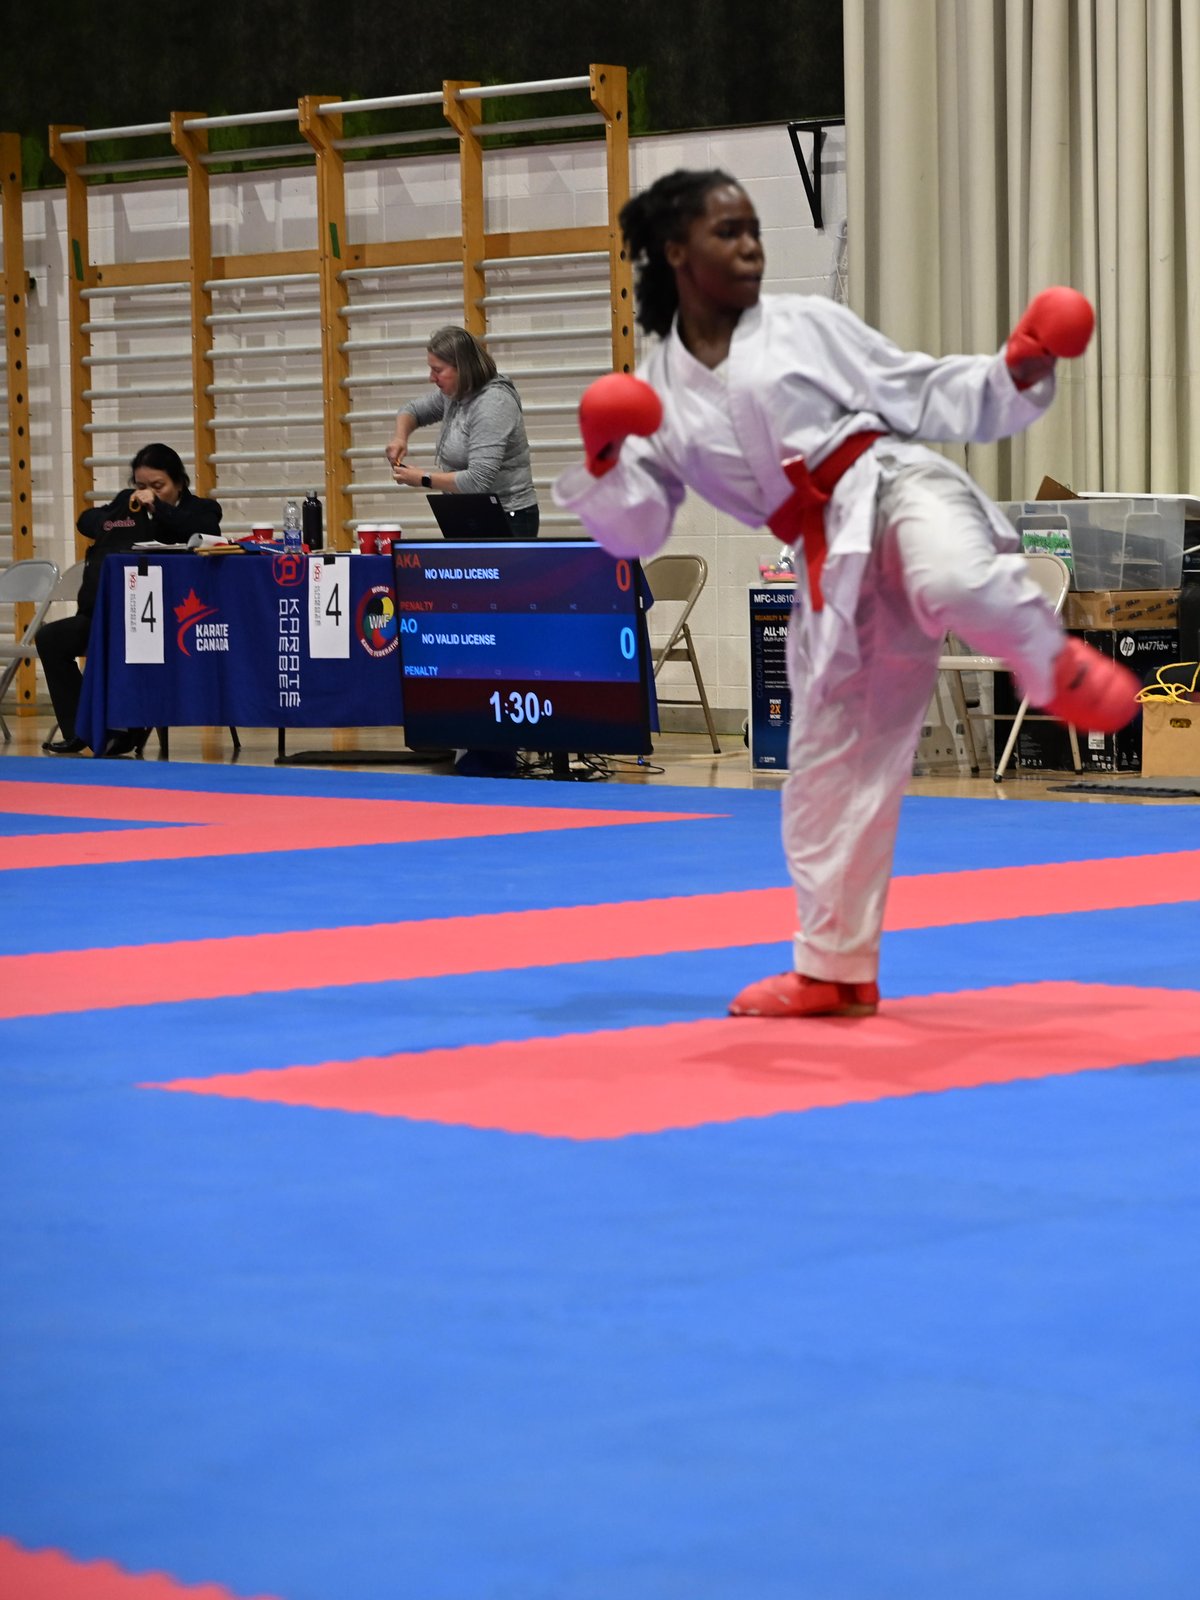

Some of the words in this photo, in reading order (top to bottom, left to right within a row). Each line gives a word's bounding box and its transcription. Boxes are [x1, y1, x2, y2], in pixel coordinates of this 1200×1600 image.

[395, 554, 421, 569] AKA
[615, 559, 631, 592] 0
[424, 568, 438, 580] NO
[439, 568, 463, 580] VALID
[464, 568, 500, 580] LICENSE
[325, 583, 342, 627] 4
[754, 593, 796, 604] MFC-L8610
[140, 591, 157, 633] 4
[400, 601, 434, 611] PENALTY
[195, 623, 229, 637] KARATE
[196, 638, 230, 651] CANADA
[400, 618, 418, 634] AO
[620, 627, 636, 660] 0
[421, 633, 435, 645] NO
[436, 634, 460, 645] VALID
[461, 634, 496, 646] LICENSE
[1137, 641, 1169, 651] M477fdw
[404, 665, 439, 677] PENALTY
